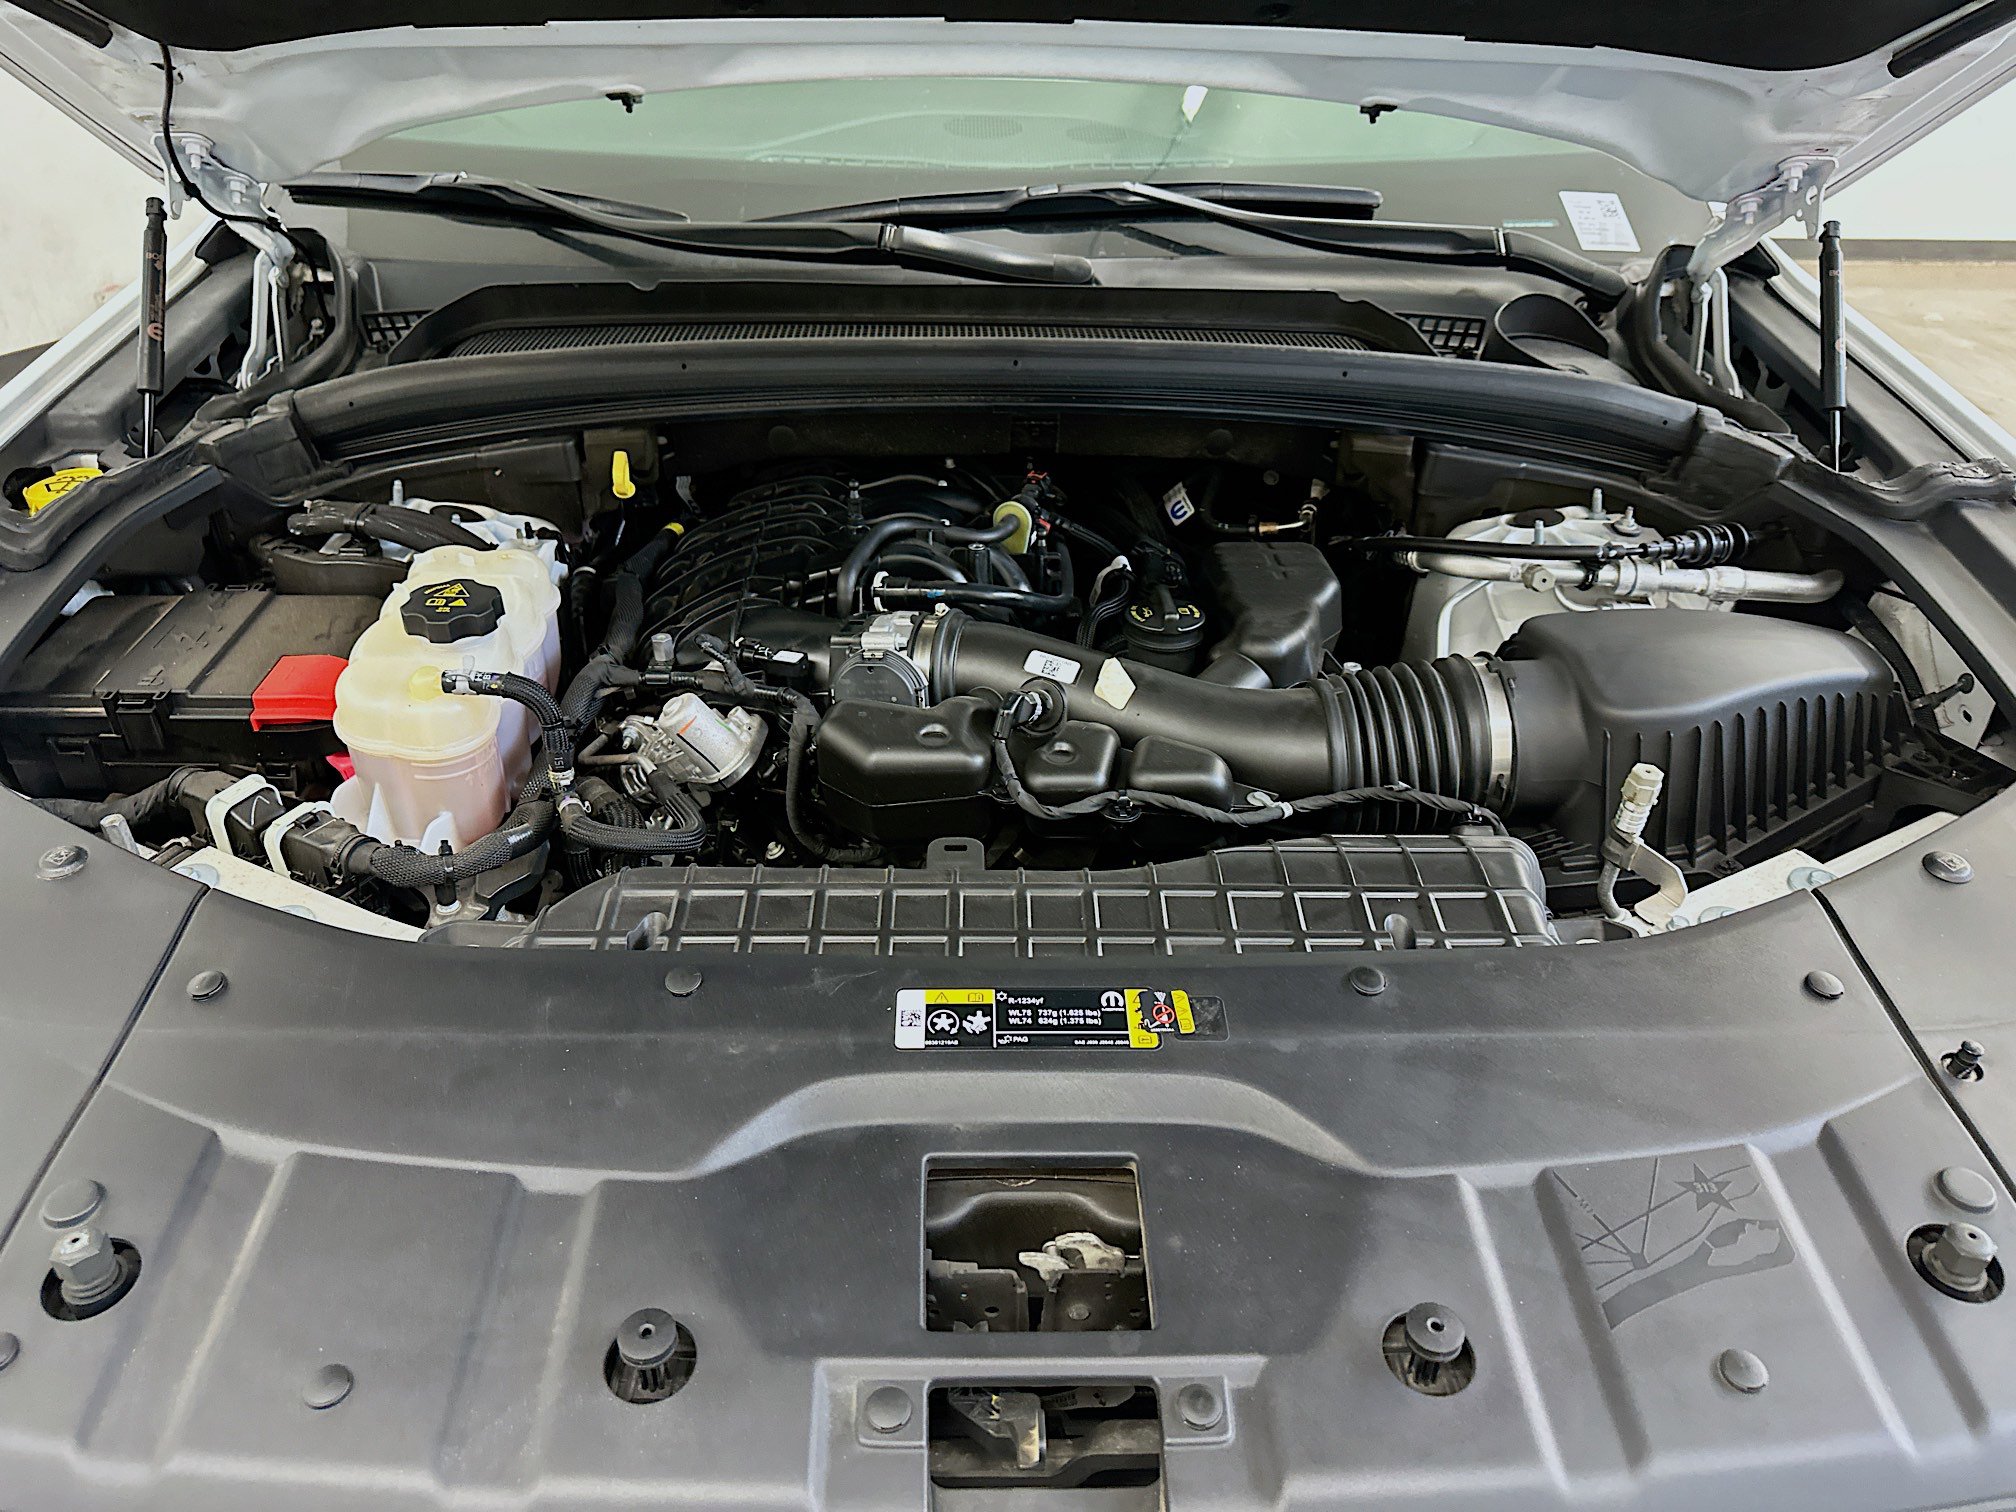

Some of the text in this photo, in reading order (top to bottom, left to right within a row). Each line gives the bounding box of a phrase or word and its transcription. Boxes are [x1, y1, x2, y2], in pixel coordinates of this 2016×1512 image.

[1008, 997, 1044, 1005] R-1234yf
[1008, 1017, 1032, 1025] WL74
[1693, 1182, 1719, 1194] 313
